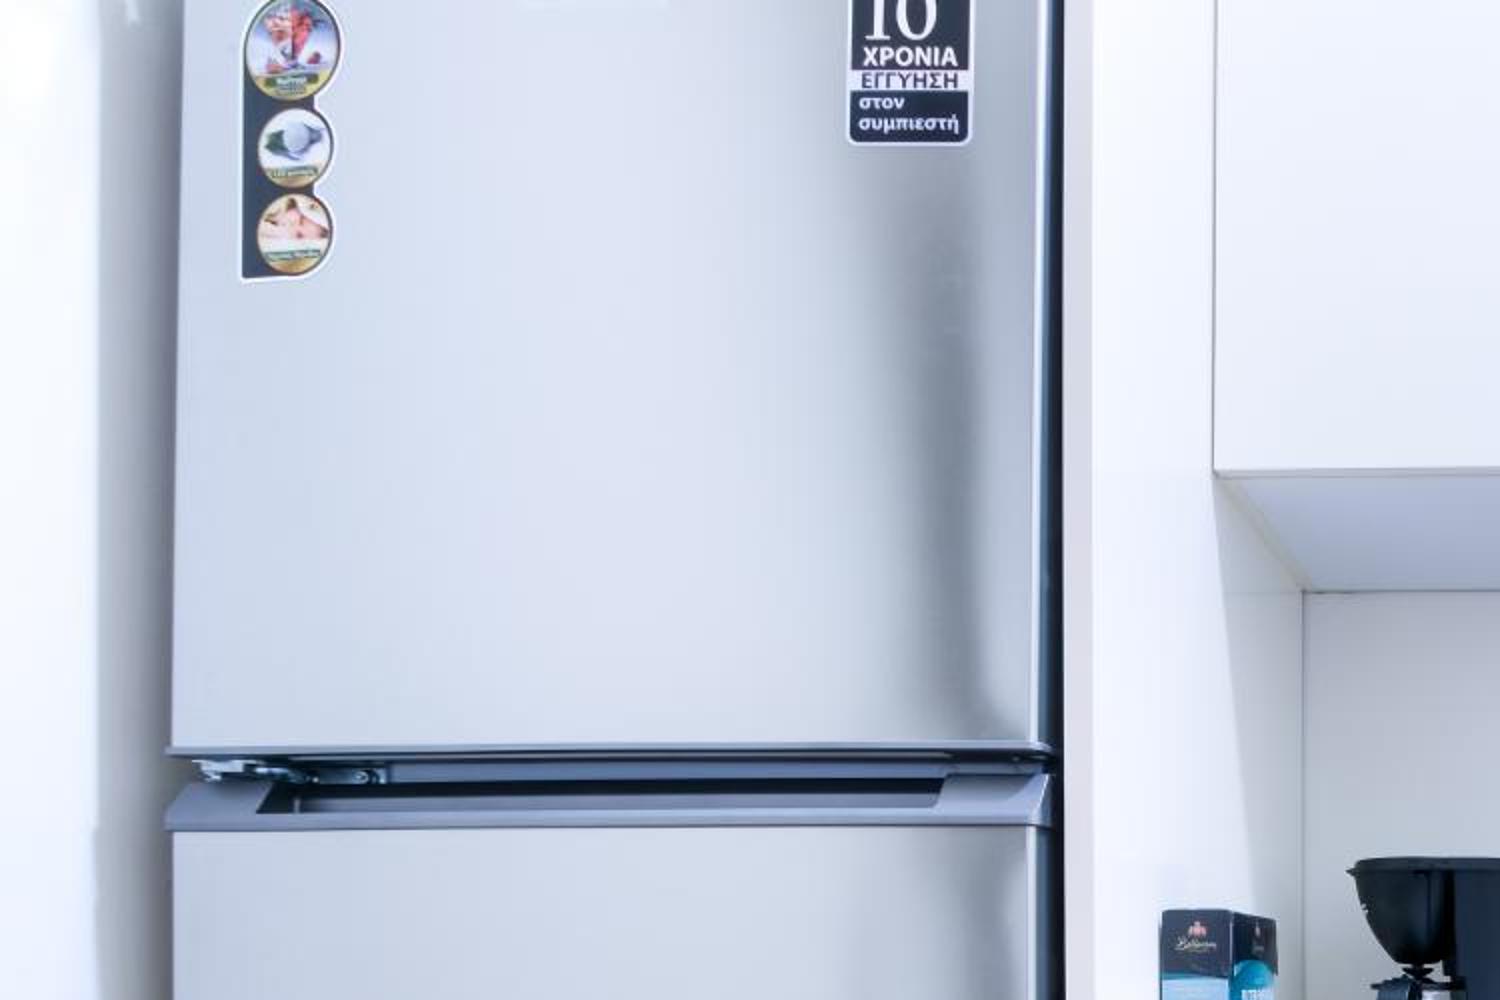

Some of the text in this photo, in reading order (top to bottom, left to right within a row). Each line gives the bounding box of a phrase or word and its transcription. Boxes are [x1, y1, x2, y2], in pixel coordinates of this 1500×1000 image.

[864, 0, 938, 41] 10
[862, 46, 959, 67] ΧΡΟΝΙΑ
[861, 71, 959, 89] ΕΓΓΥΗΣΗ
[859, 97, 905, 110] στον
[858, 113, 960, 135] συμπιεστή
